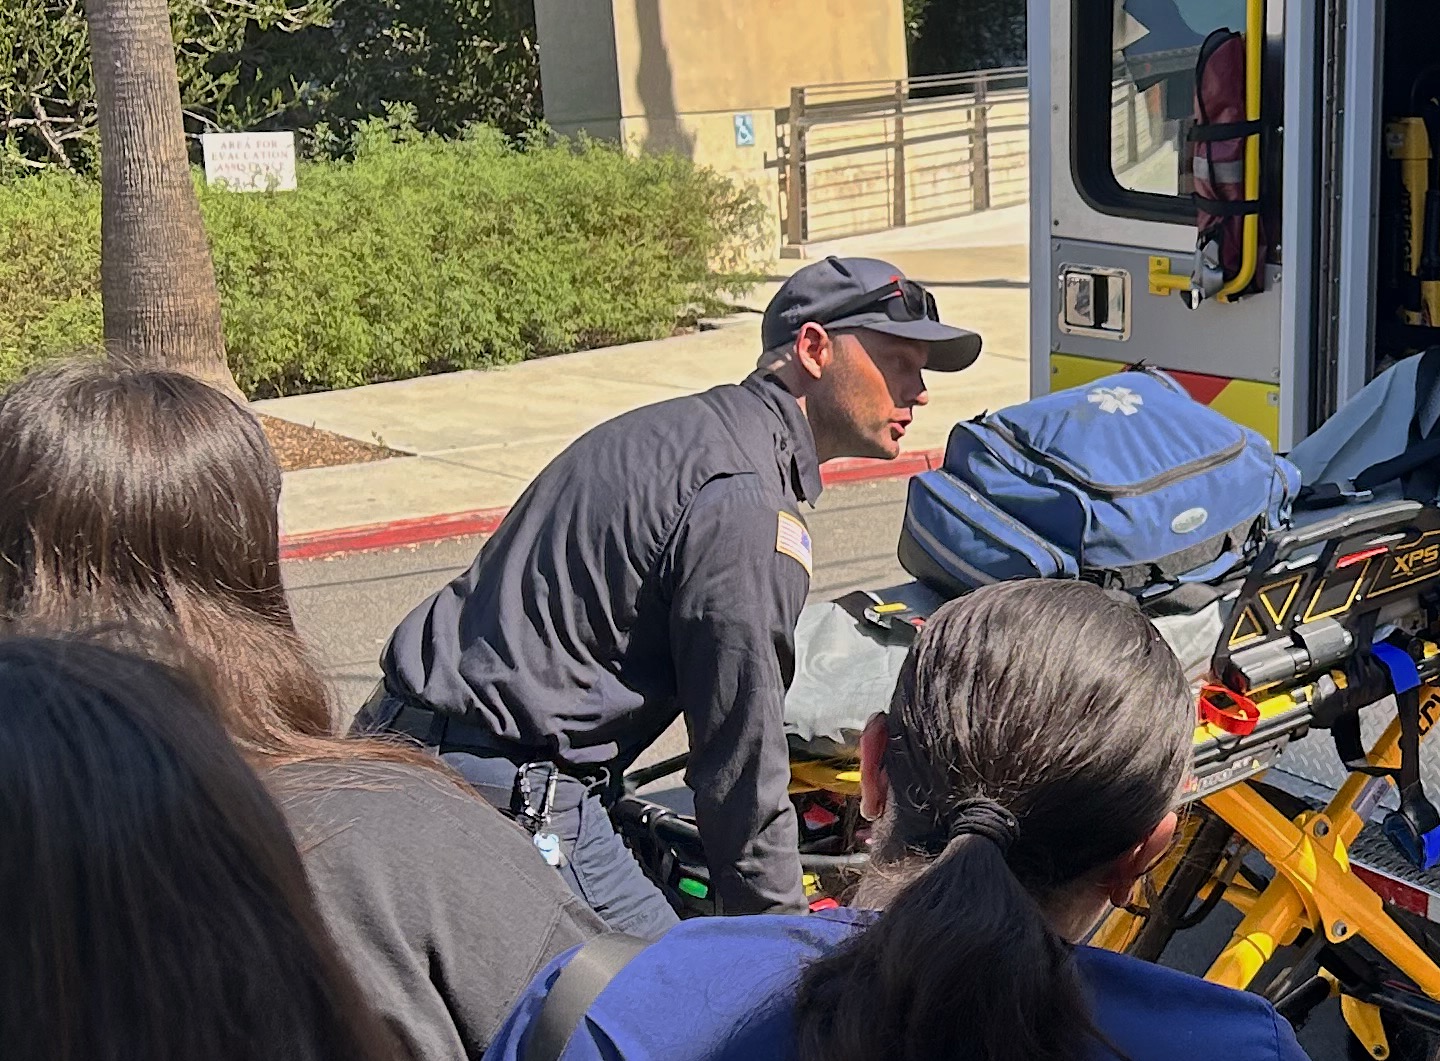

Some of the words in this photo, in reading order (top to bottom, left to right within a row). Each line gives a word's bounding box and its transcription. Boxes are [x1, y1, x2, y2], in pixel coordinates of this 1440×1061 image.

[221, 140, 250, 149] AREA
[256, 139, 278, 149] FOR
[211, 150, 288, 161] EVACUATION
[1392, 543, 1440, 574] XPS
